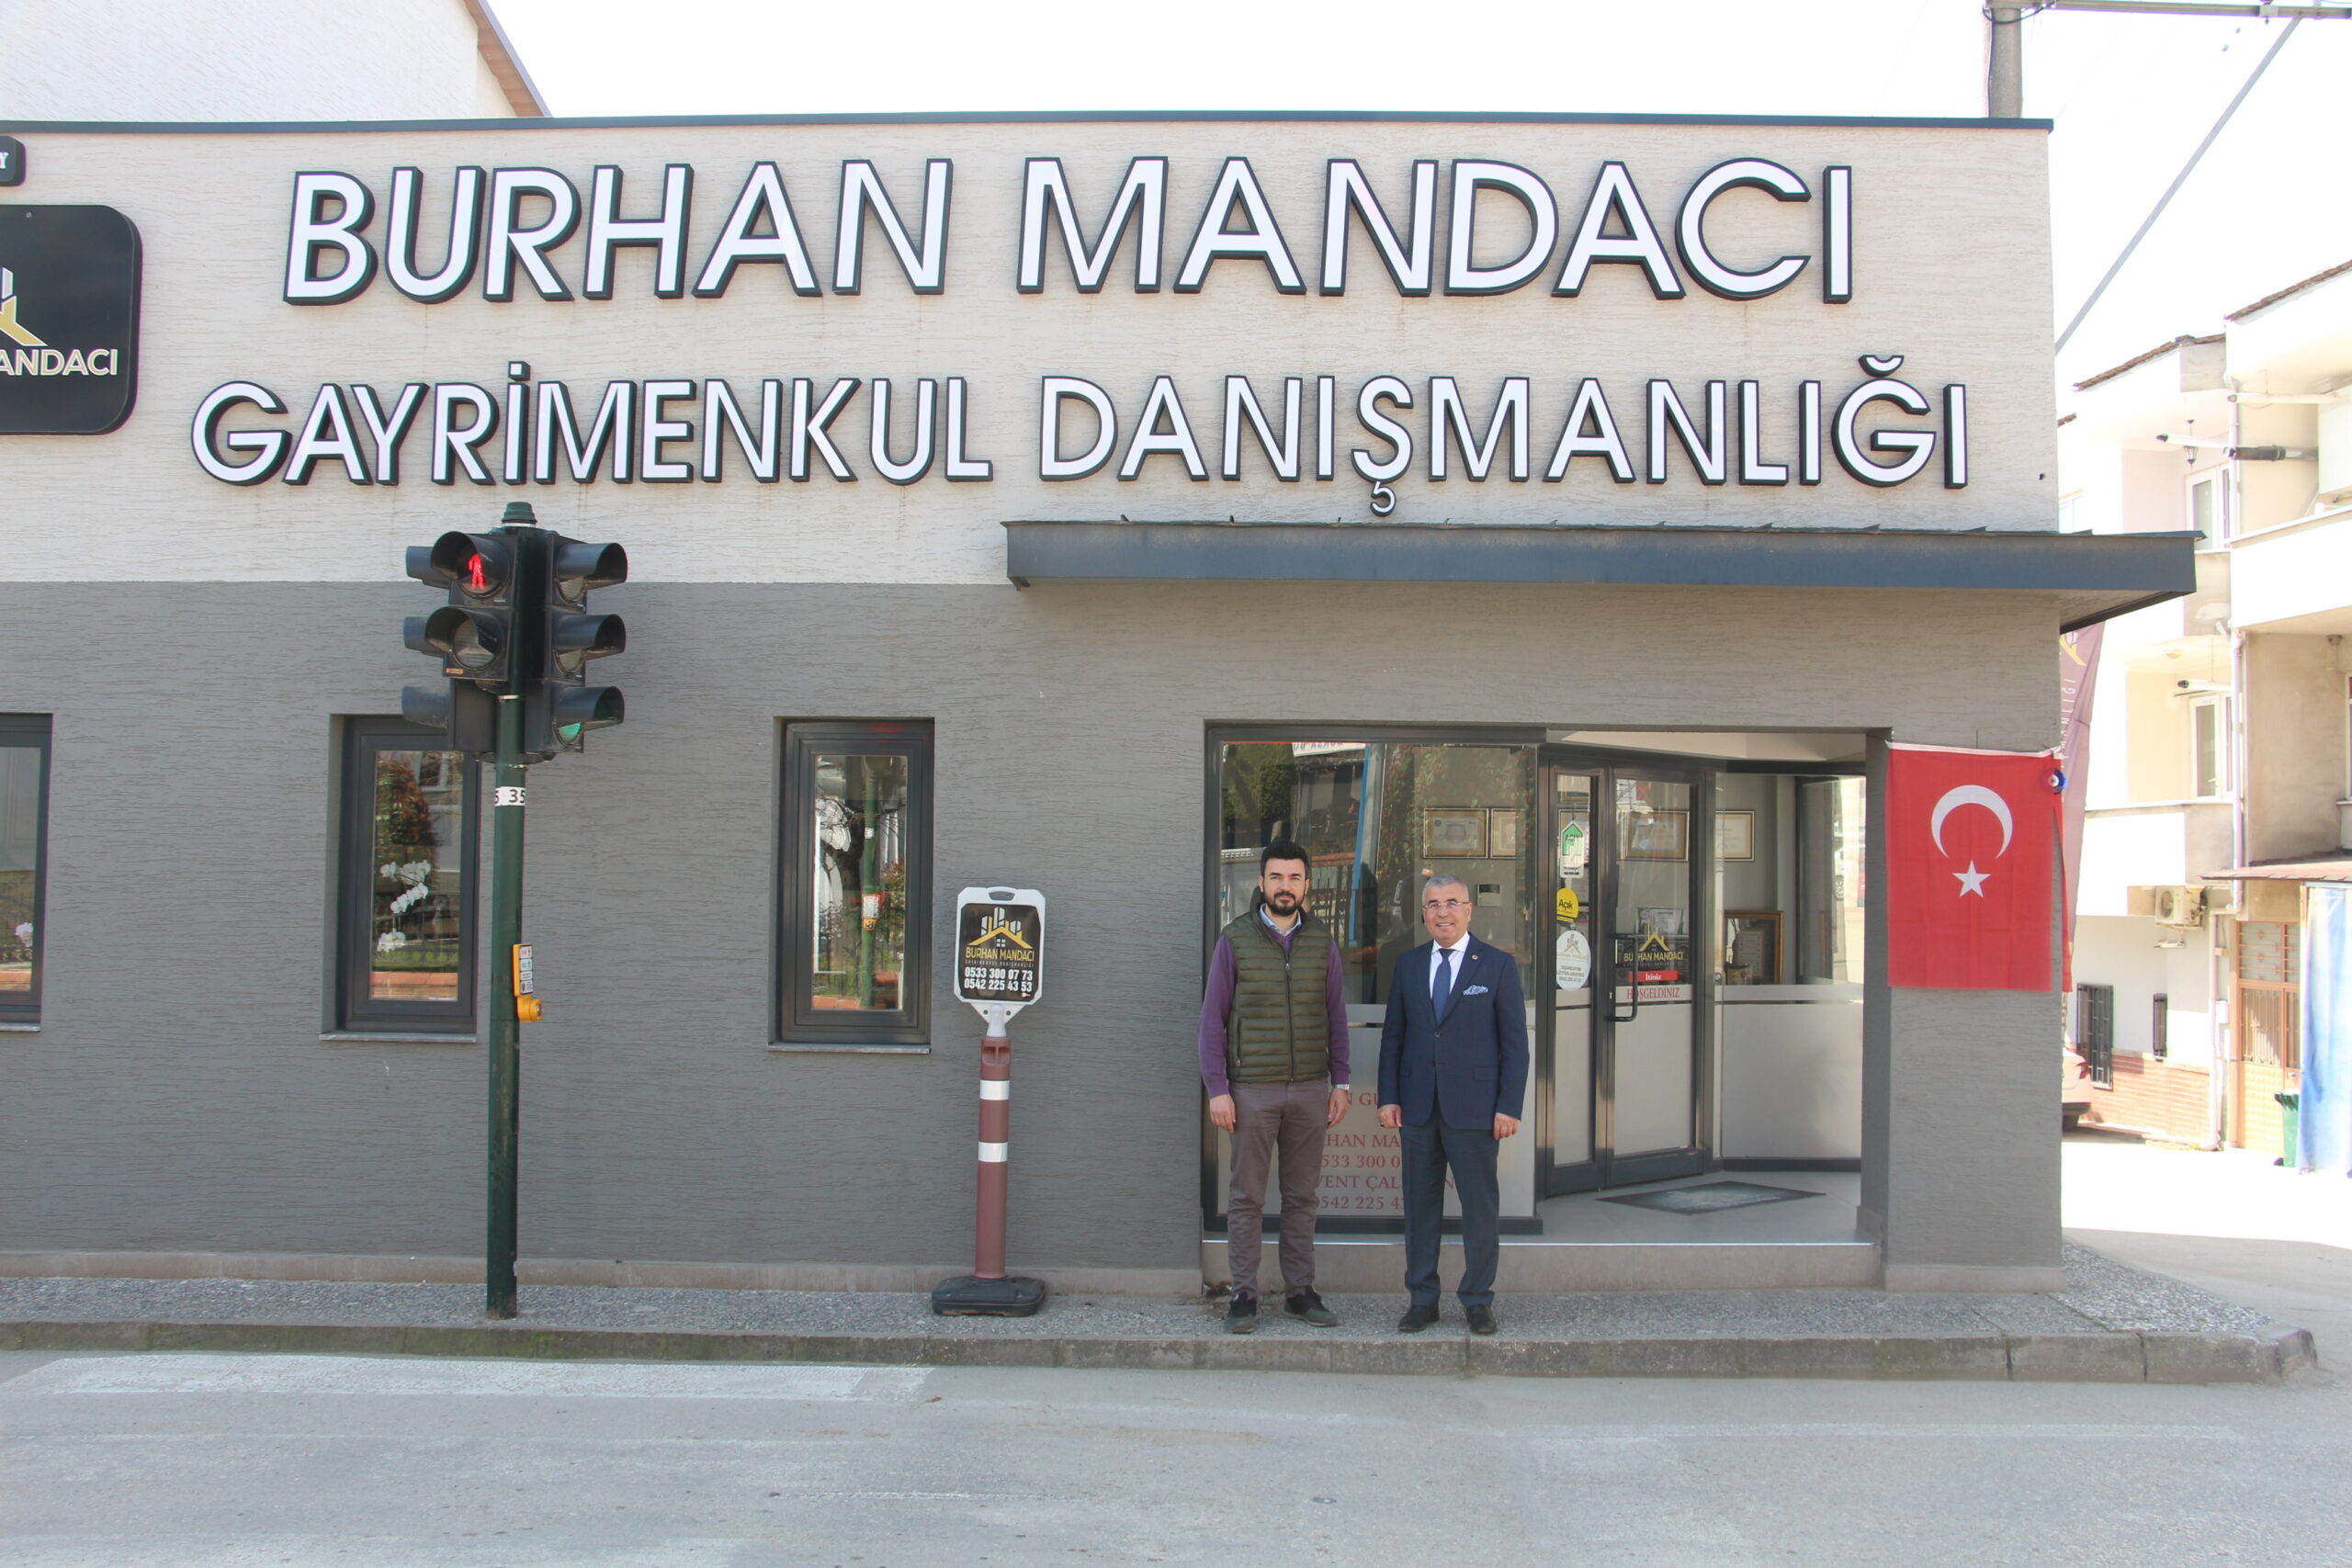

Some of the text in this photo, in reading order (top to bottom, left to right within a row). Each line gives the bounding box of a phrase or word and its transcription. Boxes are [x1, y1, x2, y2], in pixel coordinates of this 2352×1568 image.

[283, 156, 1852, 306] BURHAN MANDACI
[0, 348, 119, 376] ANDACI
[191, 354, 1969, 517] GAYRİMENKUL DANIŞMANLIĞI
[509, 789, 526, 804] 35
[1558, 898, 1574, 910] Açık
[965, 947, 1035, 962] BURHAN MANDACI
[1624, 952, 1683, 962] BUHAN MANDACI
[965, 966, 1033, 981] 0533 300 07 73
[964, 978, 1032, 992] 0542 225 43 53
[1627, 987, 1679, 1000] HŞGELDİNİZ
[1324, 1134, 1400, 1147] HAN MA
[1322, 1155, 1350, 1168] 533
[1357, 1155, 1385, 1168] 300
[1356, 1196, 1384, 1209] 225
[1390, 1197, 1405, 1210] 4
